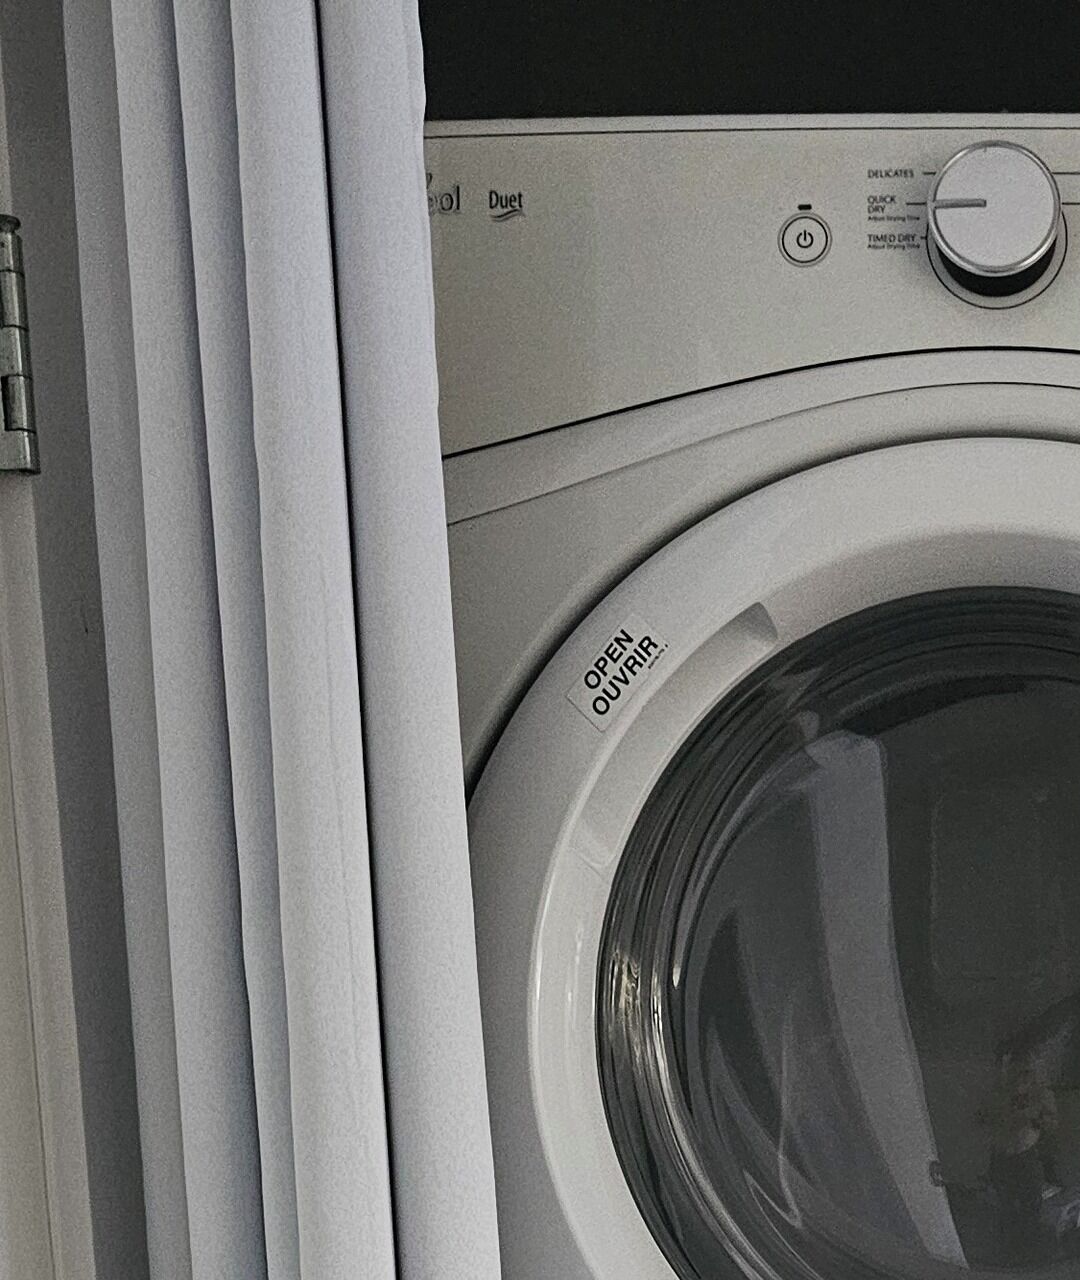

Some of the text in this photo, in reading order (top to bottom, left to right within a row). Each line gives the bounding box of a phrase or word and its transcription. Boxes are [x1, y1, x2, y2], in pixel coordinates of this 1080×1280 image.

[867, 169, 914, 179] DELICATES
[488, 189, 523, 209] Duet
[867, 195, 897, 205] QUICK
[867, 205, 886, 214] DRY
[867, 234, 916, 243] TIMED DRY
[583, 628, 634, 690] OPEN
[592, 635, 659, 716] OUVRIR
